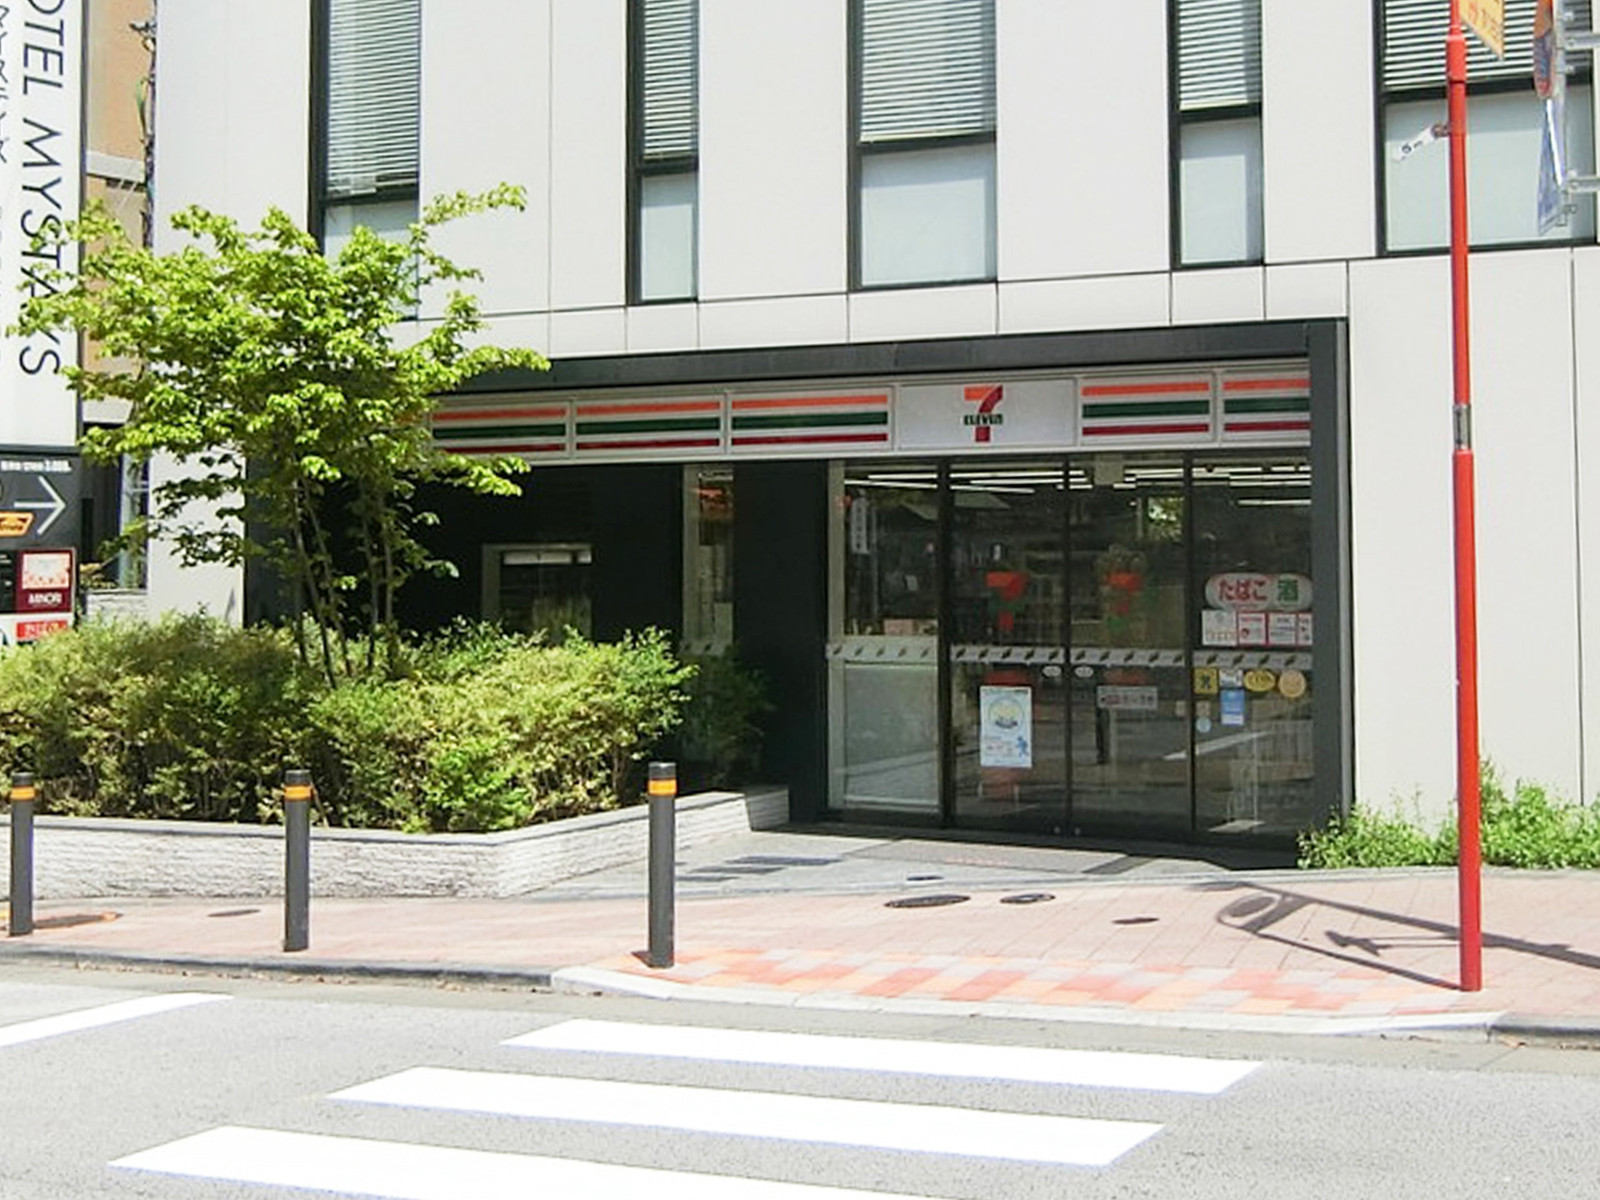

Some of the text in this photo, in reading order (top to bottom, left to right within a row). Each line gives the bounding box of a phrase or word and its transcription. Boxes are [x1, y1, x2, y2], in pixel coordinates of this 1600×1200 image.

[963, 384, 1003, 443] 7
[1219, 579, 1267, 601] たばこ
